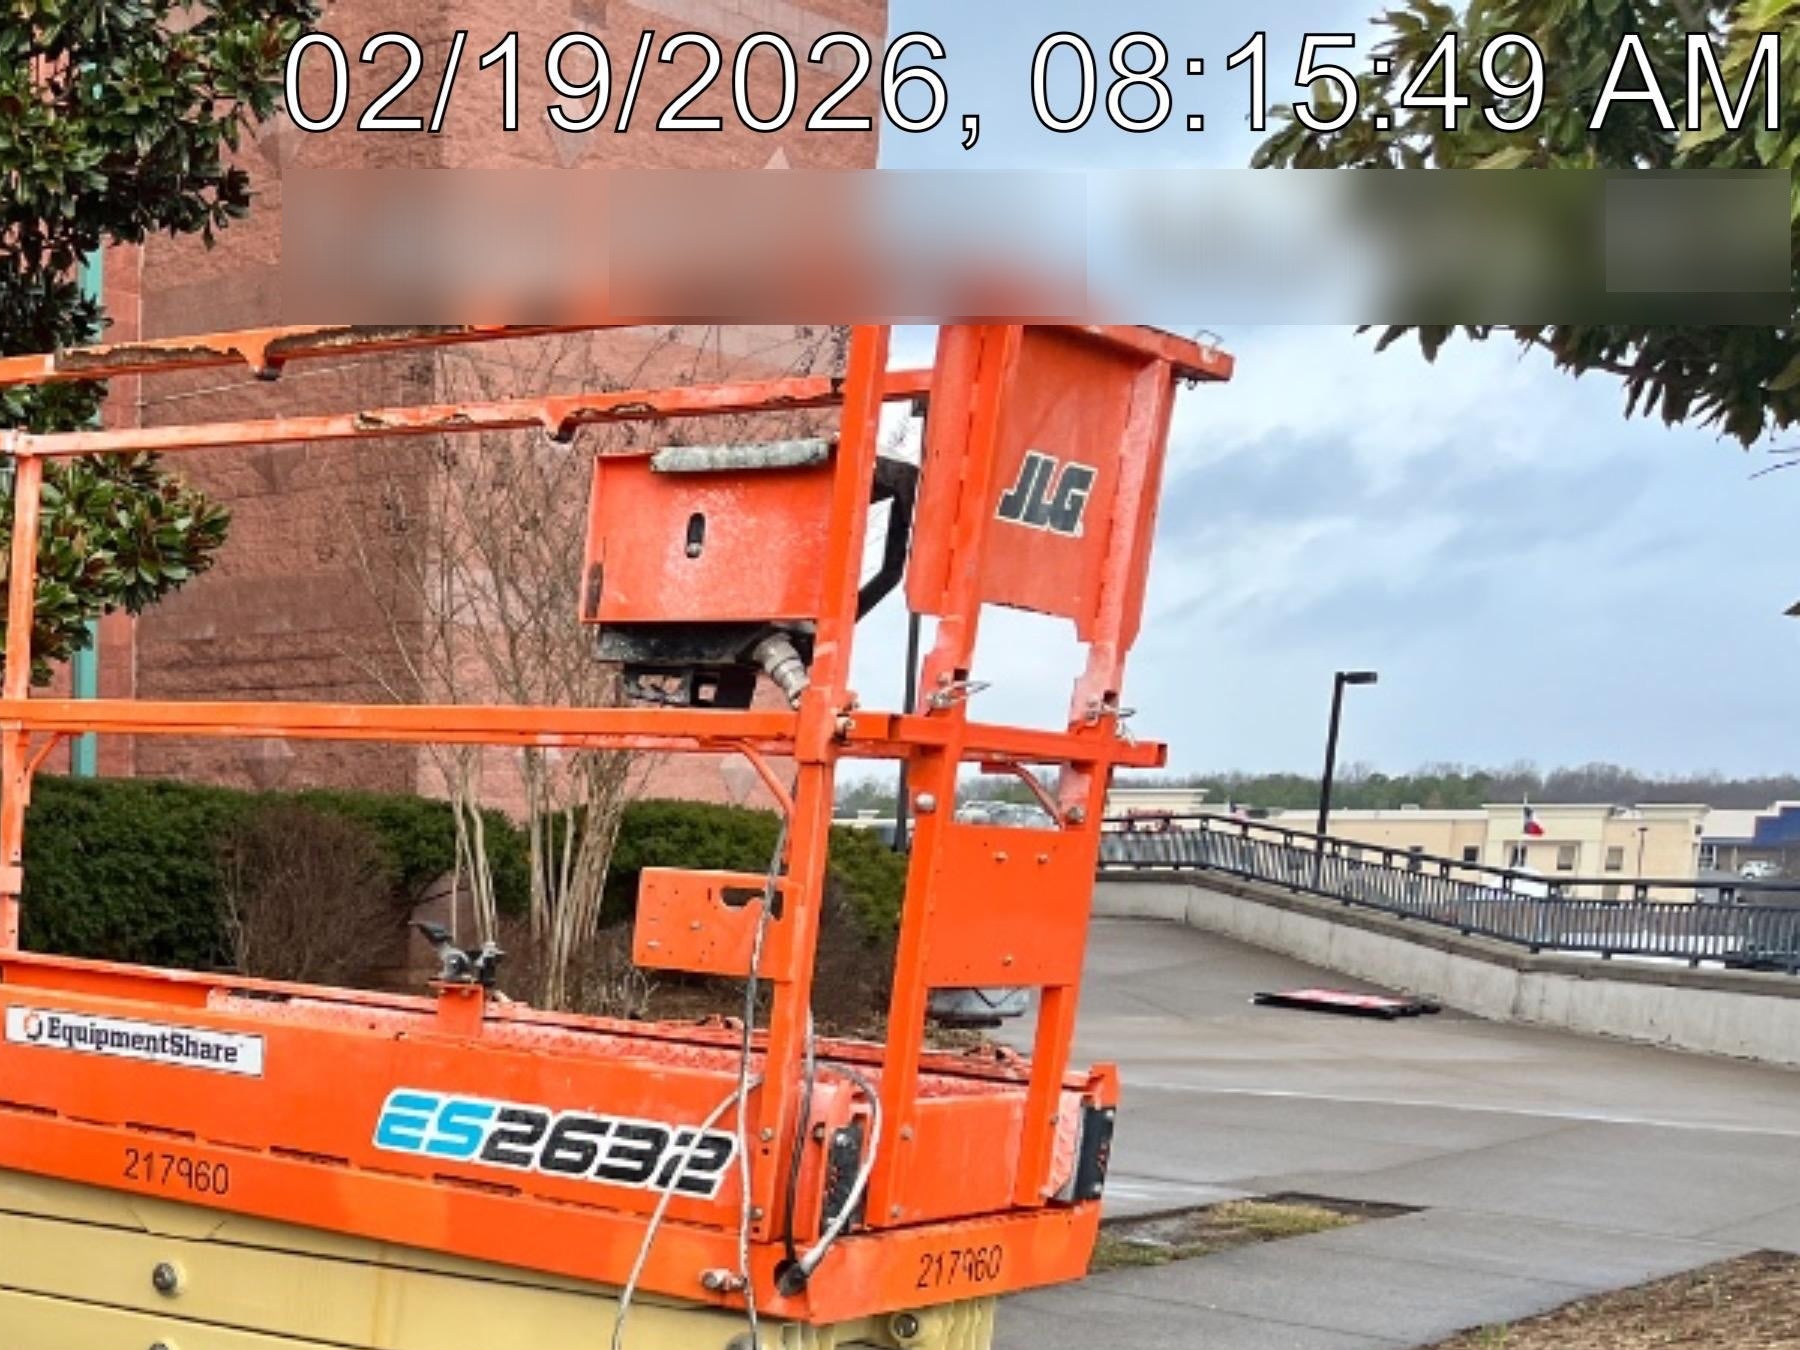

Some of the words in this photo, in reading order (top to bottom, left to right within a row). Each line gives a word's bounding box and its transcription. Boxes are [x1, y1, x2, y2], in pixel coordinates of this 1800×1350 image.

[995, 451, 1098, 537] JLG
[48, 1016, 238, 1063] EquipmentShare
[374, 1089, 741, 1199] ES2632
[122, 1147, 230, 1195] 217960
[916, 1244, 1003, 1288] 217960
